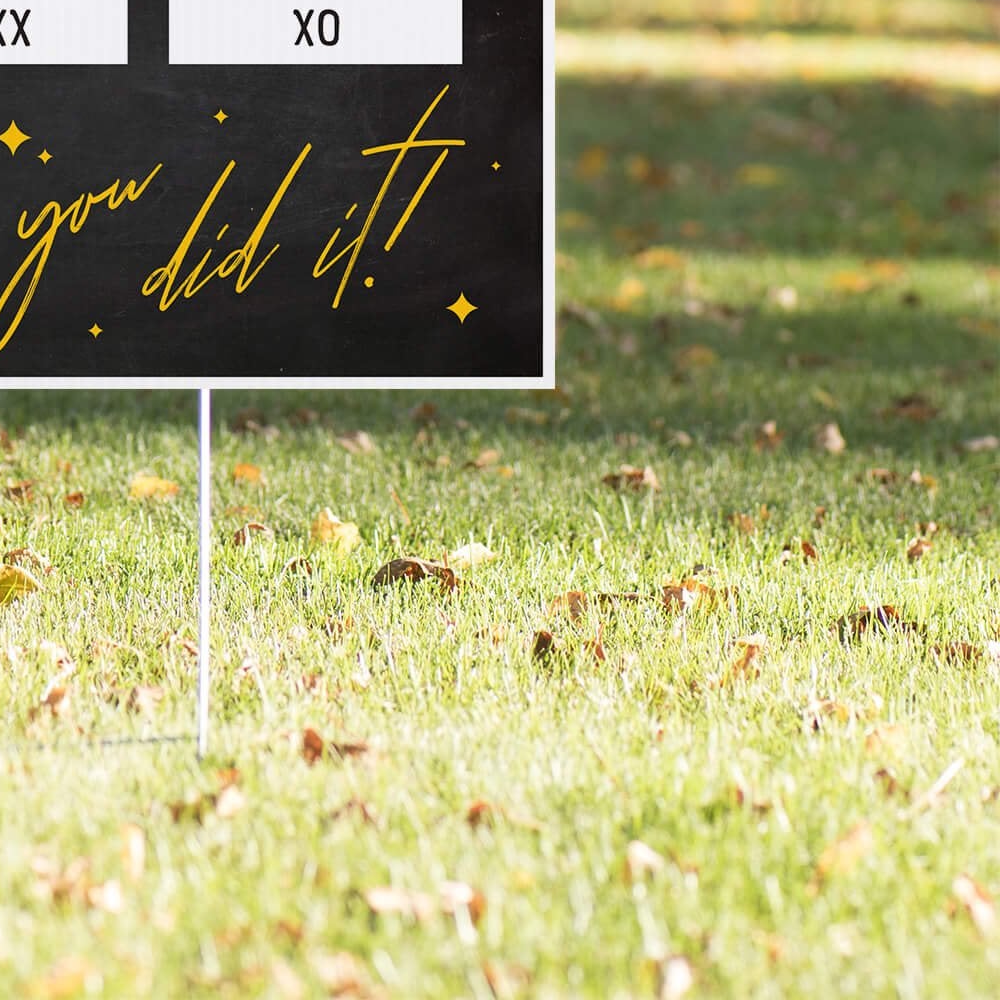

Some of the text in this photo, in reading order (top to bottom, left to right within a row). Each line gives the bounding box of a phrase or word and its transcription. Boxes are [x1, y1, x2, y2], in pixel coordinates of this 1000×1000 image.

[292, 8, 340, 48] XO
[140, 142, 313, 312] did
[312, 83, 467, 309] it!
